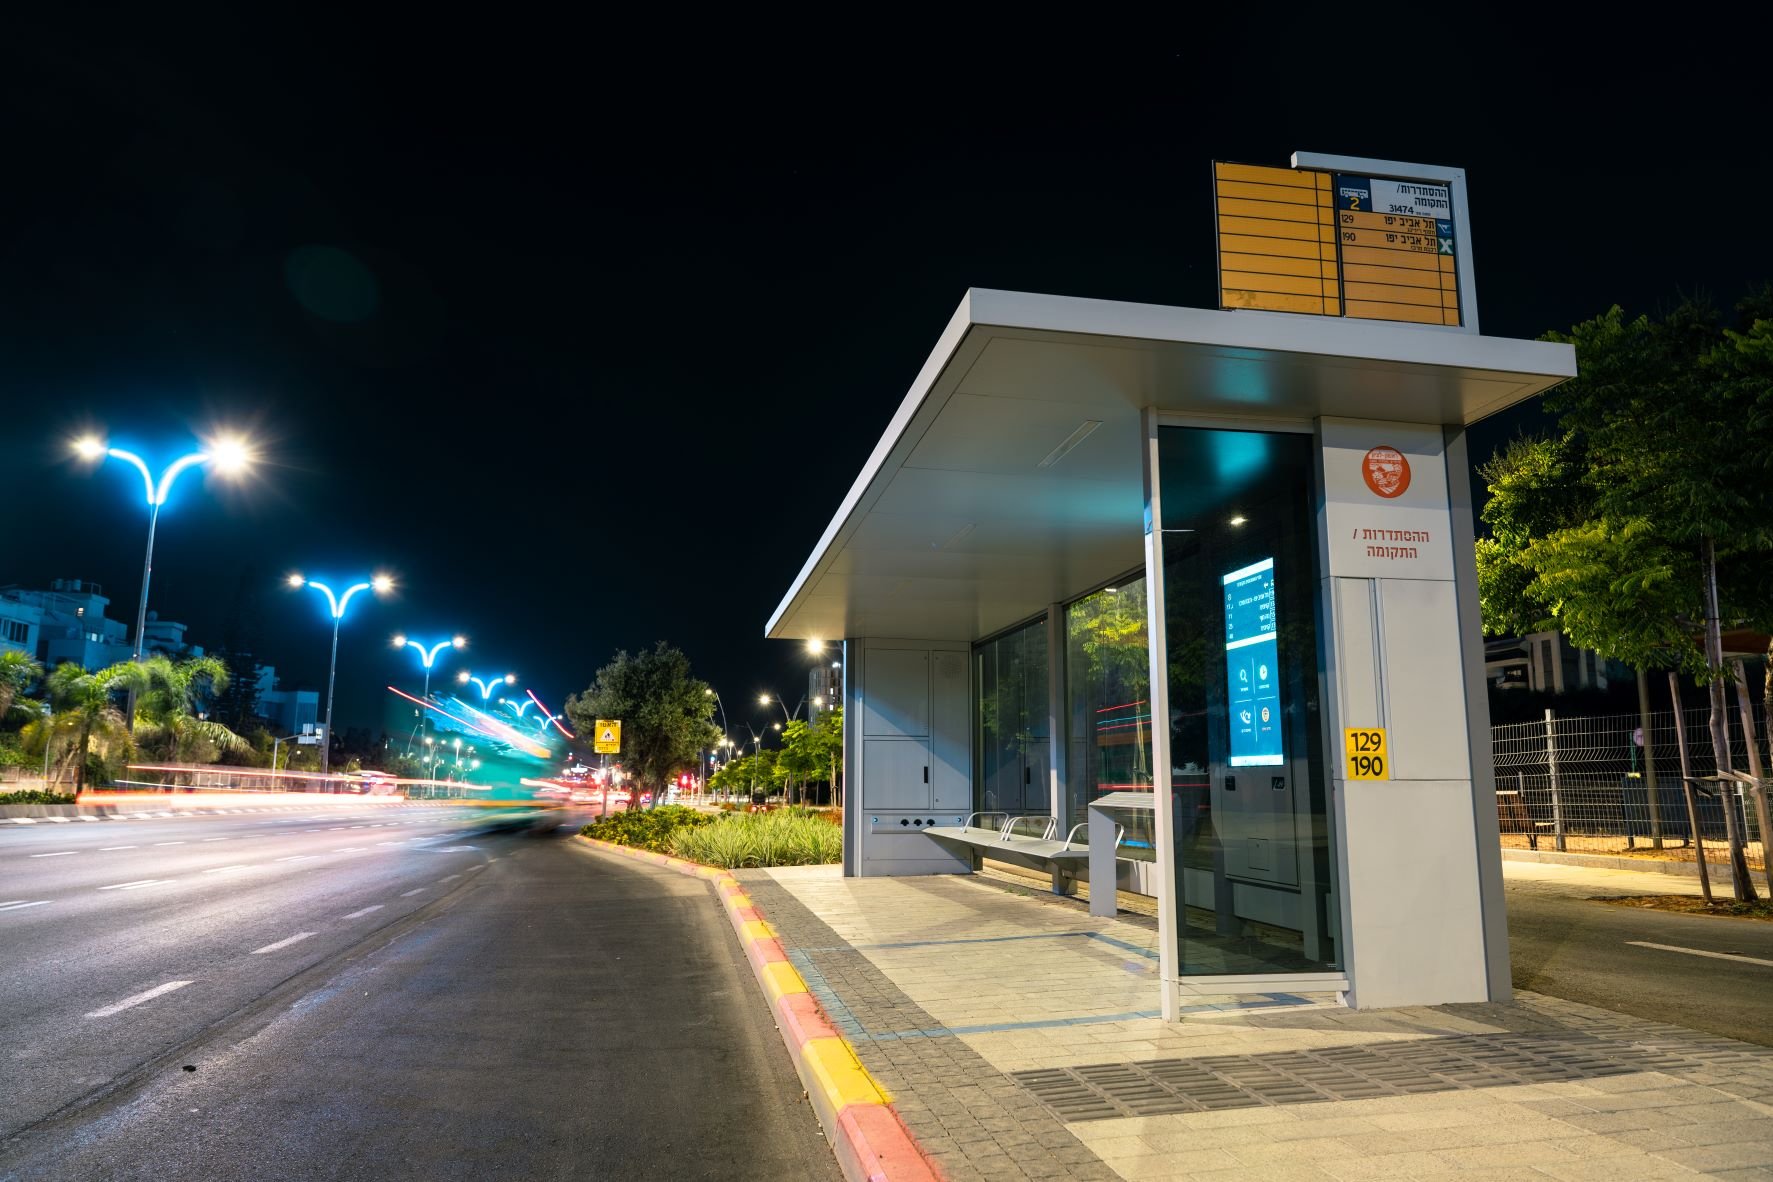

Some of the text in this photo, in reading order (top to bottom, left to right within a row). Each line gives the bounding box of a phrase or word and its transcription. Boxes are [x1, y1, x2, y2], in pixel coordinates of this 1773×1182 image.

[1397, 184, 1447, 198] ההסתדרות/
[1350, 197, 1360, 210] 2
[1389, 205, 1414, 214] 31474
[1415, 197, 1448, 209] התקומה
[1341, 214, 1354, 223] 129
[1384, 216, 1434, 229] תל אביב יפו
[1343, 232, 1356, 241] 190
[1386, 233, 1436, 247] תל אביב יפו
[1363, 529, 1429, 542] ההסתדרות
[1367, 546, 1417, 560] התקומה
[1351, 732, 1381, 752] 129
[1351, 756, 1383, 776] 190
